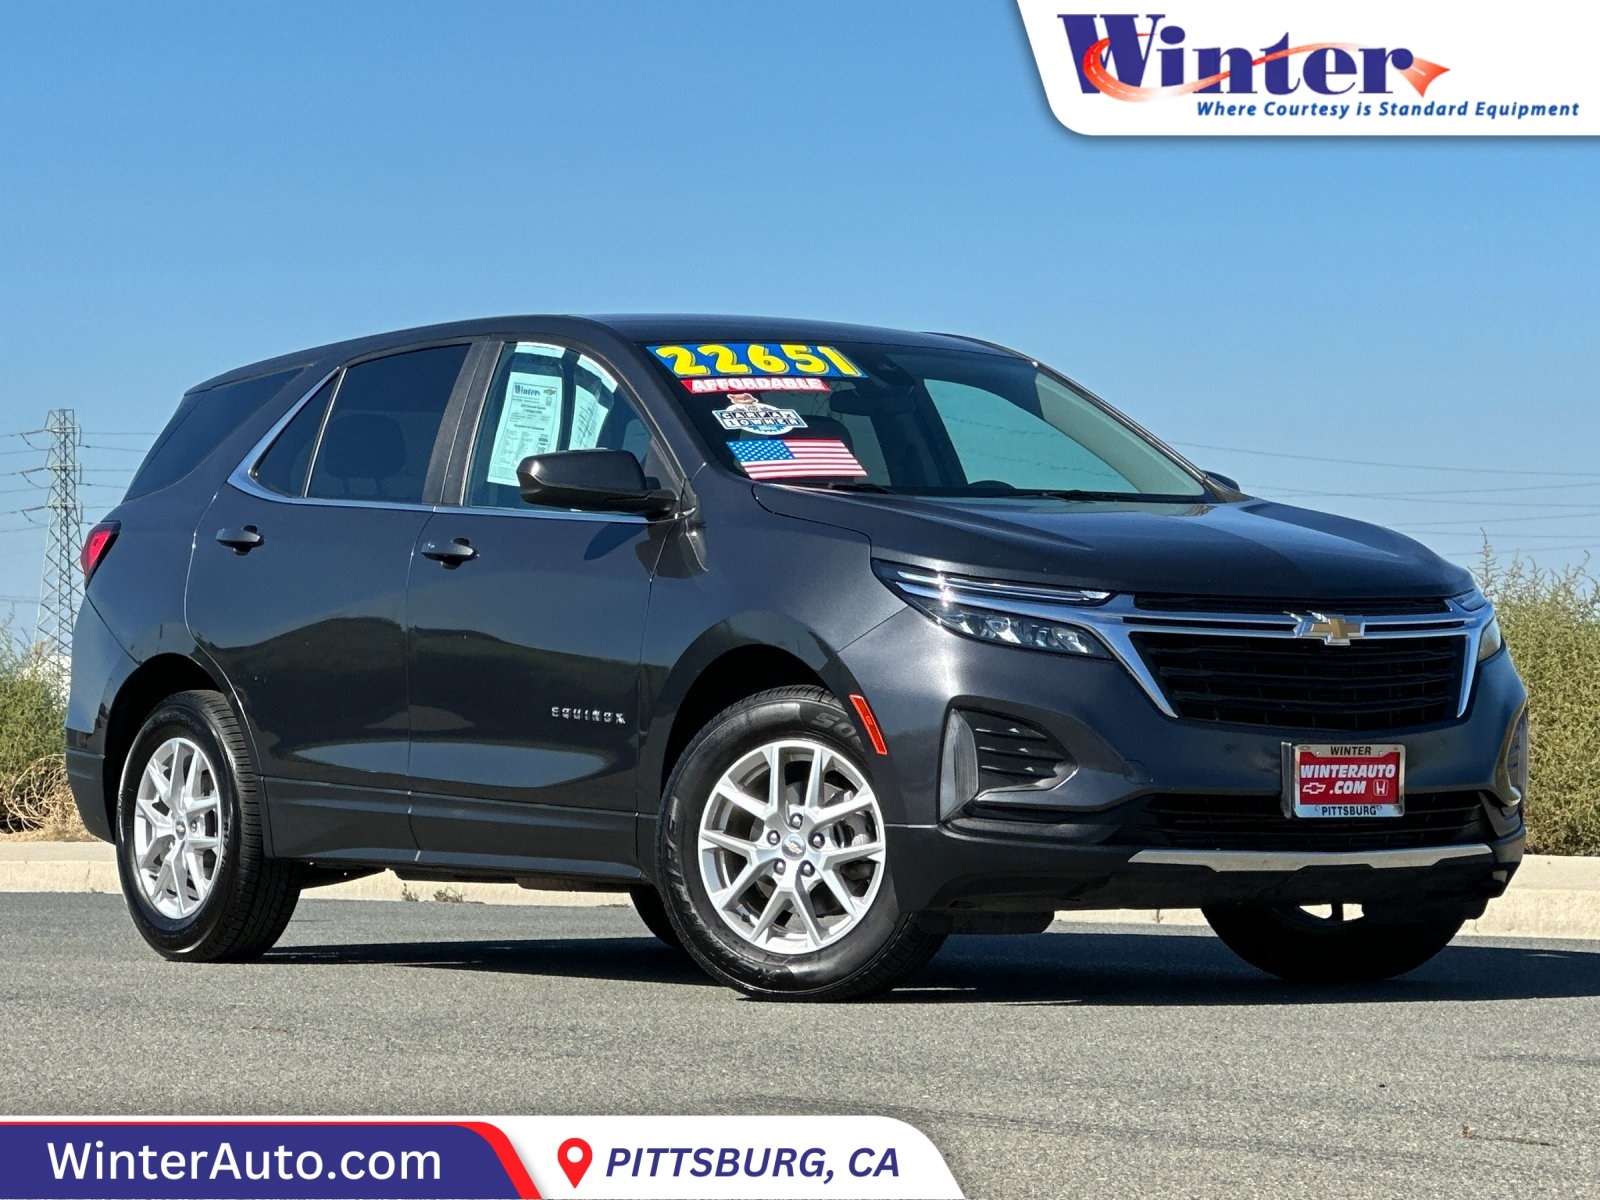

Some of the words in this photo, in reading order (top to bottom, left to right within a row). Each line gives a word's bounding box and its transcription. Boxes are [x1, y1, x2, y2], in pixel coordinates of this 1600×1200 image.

[656, 344, 861, 376] 22651
[691, 378, 825, 393] AFFORDABLE
[551, 706, 626, 725] EQUINOX
[1330, 746, 1372, 756] WINTER
[1300, 764, 1397, 779] WINTERAUTO
[1329, 780, 1367, 795] .COM
[1321, 805, 1377, 816] PITTSBURG
